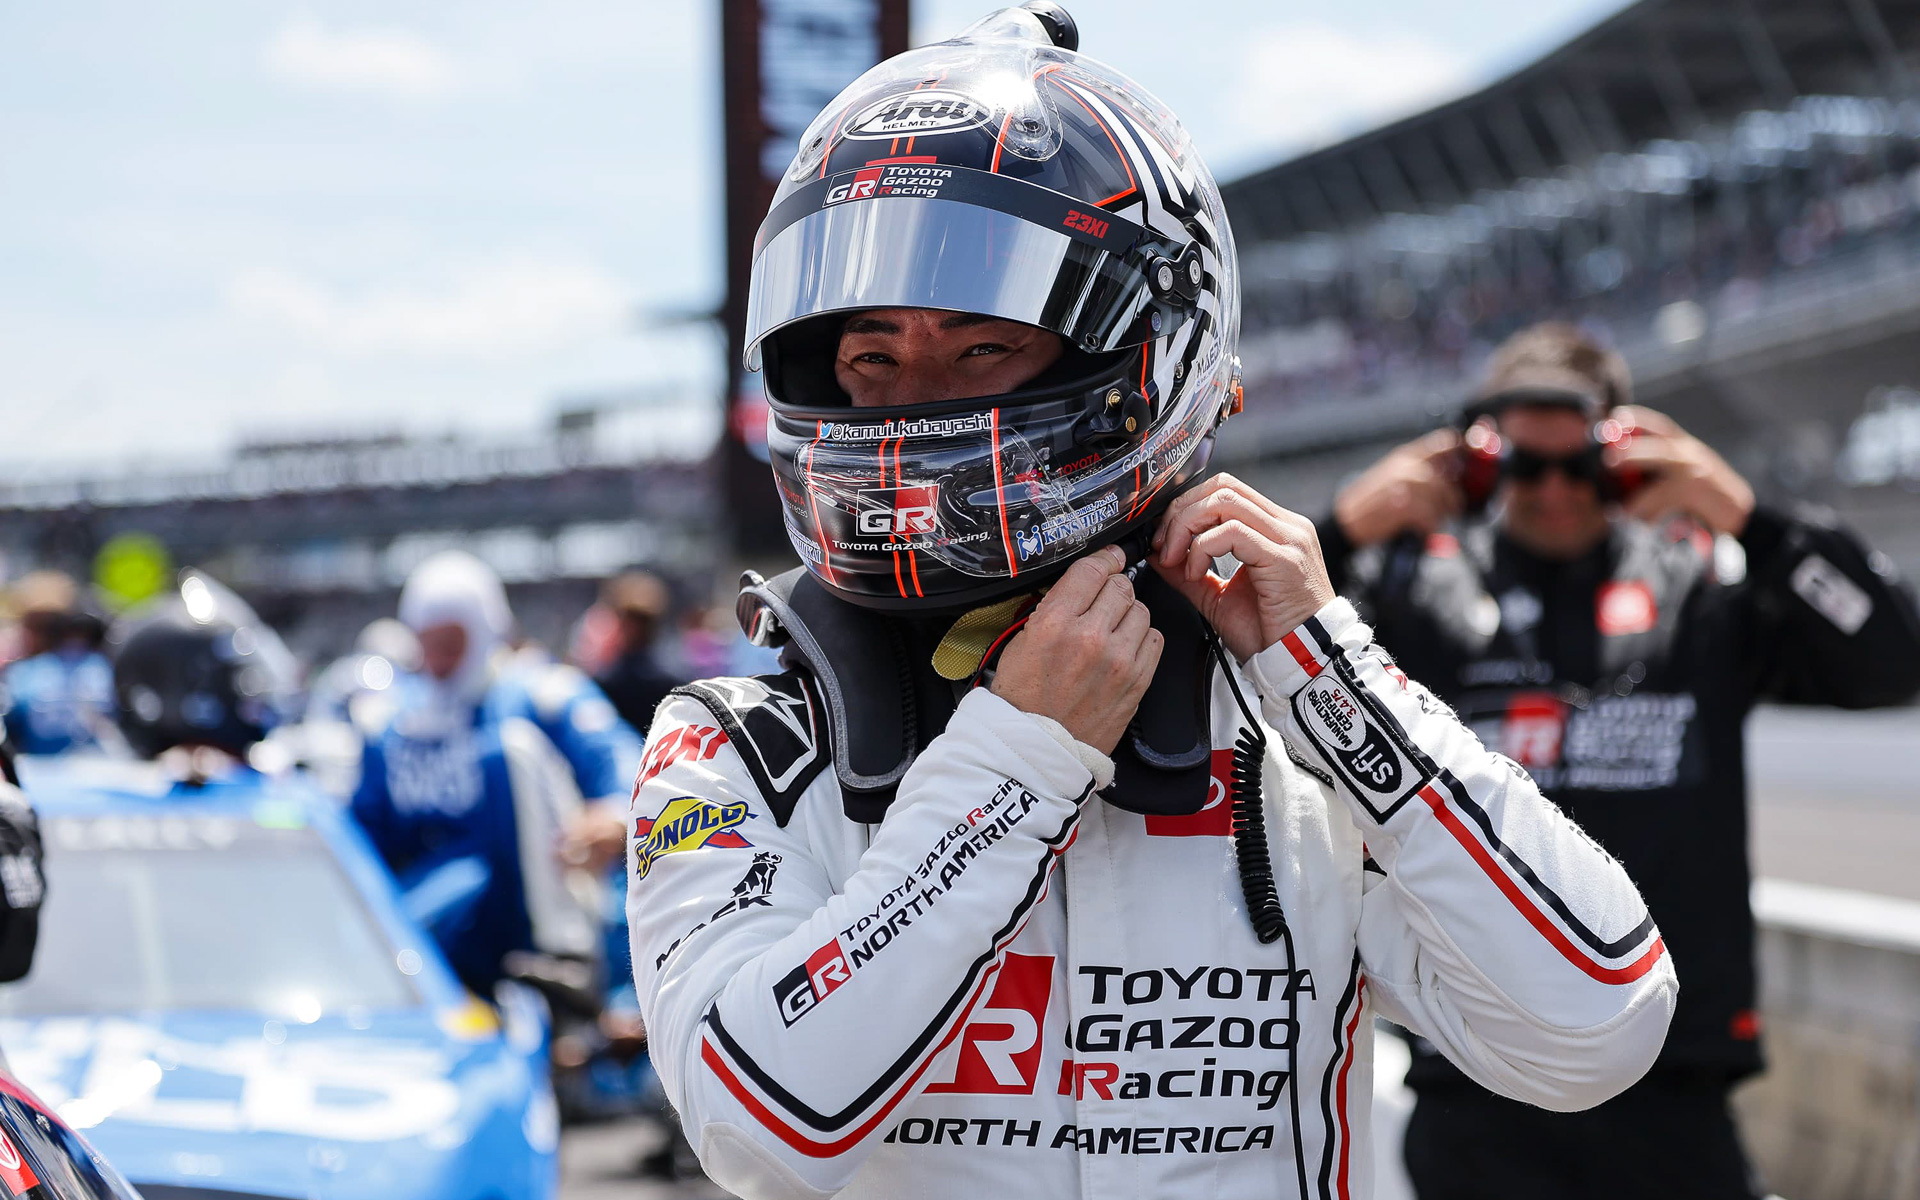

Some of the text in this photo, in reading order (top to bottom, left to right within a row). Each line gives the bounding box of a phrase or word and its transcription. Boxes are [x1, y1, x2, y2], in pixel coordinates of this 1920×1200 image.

[874, 98, 976, 123] Arai
[882, 120, 936, 131] HELMET
[881, 176, 944, 187] GAZOO
[887, 166, 953, 178] TOYOTA
[826, 179, 877, 204] GR
[878, 185, 938, 198] Racing
[1063, 210, 1109, 239] 23XI
[831, 412, 992, 440] @kamui_kobayashi
[1057, 452, 1102, 477] TOYOTA
[860, 506, 934, 533] GR
[832, 540, 879, 551] TOYOTA
[881, 541, 933, 551] GAZOO
[1307, 688, 1353, 748] MANUFACTURER
[1319, 689, 1354, 734] CERTIFIED
[1351, 743, 1394, 785] sfi
[637, 802, 743, 876] SUNOCO
[840, 875, 917, 942] TOYOTA
[915, 823, 969, 879] GAZOO
[850, 789, 1040, 970] NORTH AMERICA
[782, 955, 850, 1022] GR
[1079, 965, 1317, 1005] TOYOTA
[1064, 1013, 1299, 1053] GAZOO
[1057, 1057, 1291, 1111] Racing
[1049, 1123, 1275, 1155] AMERICA
